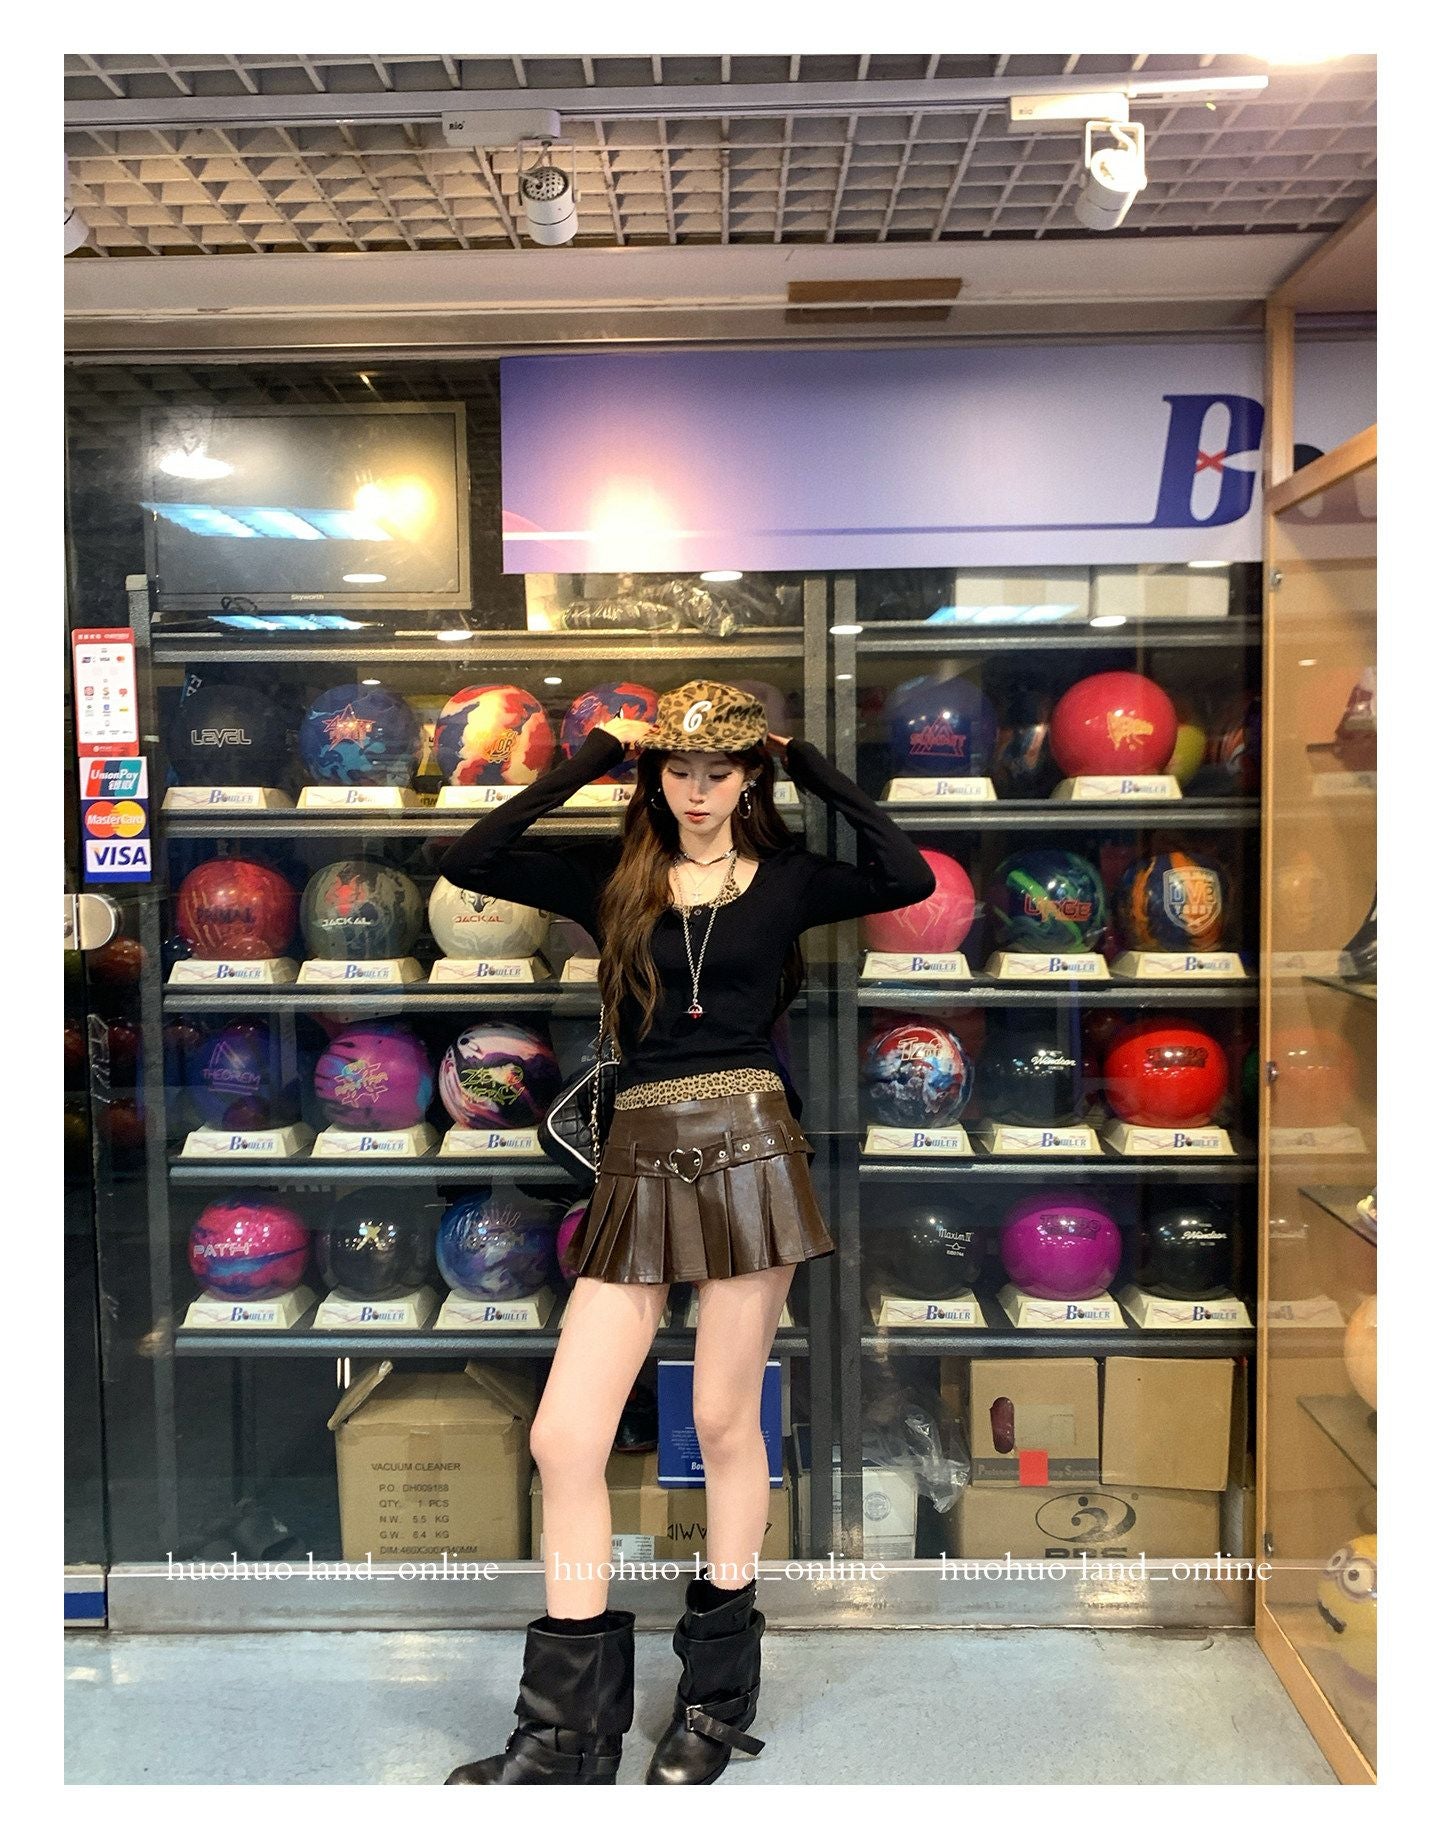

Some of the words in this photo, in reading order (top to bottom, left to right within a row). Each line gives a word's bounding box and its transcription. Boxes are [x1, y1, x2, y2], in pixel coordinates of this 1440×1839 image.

[91, 769, 138, 783] UnionPay
[88, 814, 144, 825] MasterCard
[94, 846, 147, 866] VISA
[321, 918, 371, 927] JACKAL
[455, 914, 505, 923] JACKAL
[371, 1463, 412, 1471] VACUUM
[415, 1463, 461, 1471] CLEANER
[429, 1500, 449, 1508] PCS
[435, 1515, 449, 1523] KG
[435, 1531, 449, 1539] KG
